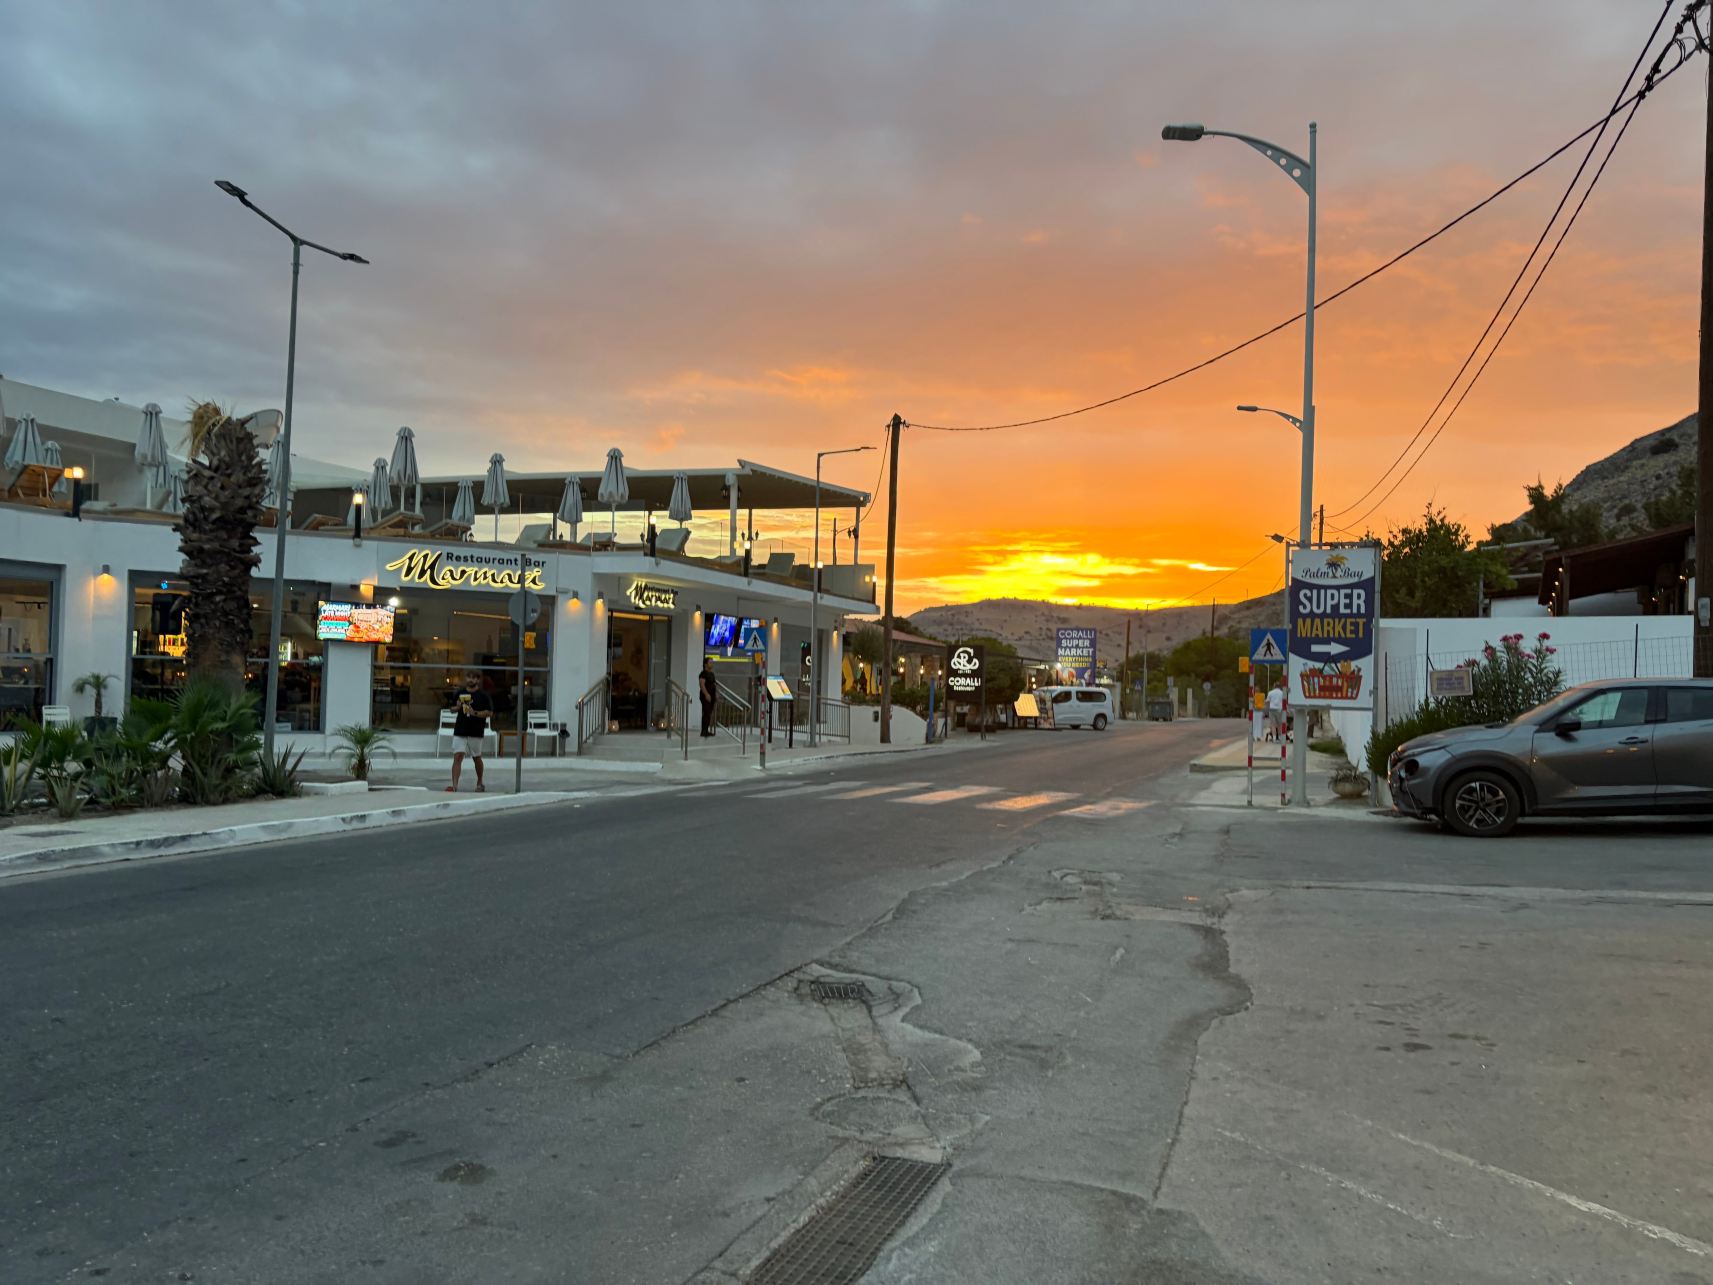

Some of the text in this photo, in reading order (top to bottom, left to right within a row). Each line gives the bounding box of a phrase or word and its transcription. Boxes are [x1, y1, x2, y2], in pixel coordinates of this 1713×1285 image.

[446, 552, 547, 568] Restaurant Bar
[1301, 567, 1365, 581] Palm Bay
[1299, 589, 1366, 614] SUPER
[1297, 617, 1366, 638] MARKET
[1058, 630, 1095, 639] CORALLI
[1061, 639, 1090, 647] SUPER
[1057, 648, 1094, 656] MARKET
[948, 677, 981, 687] CORALLI
